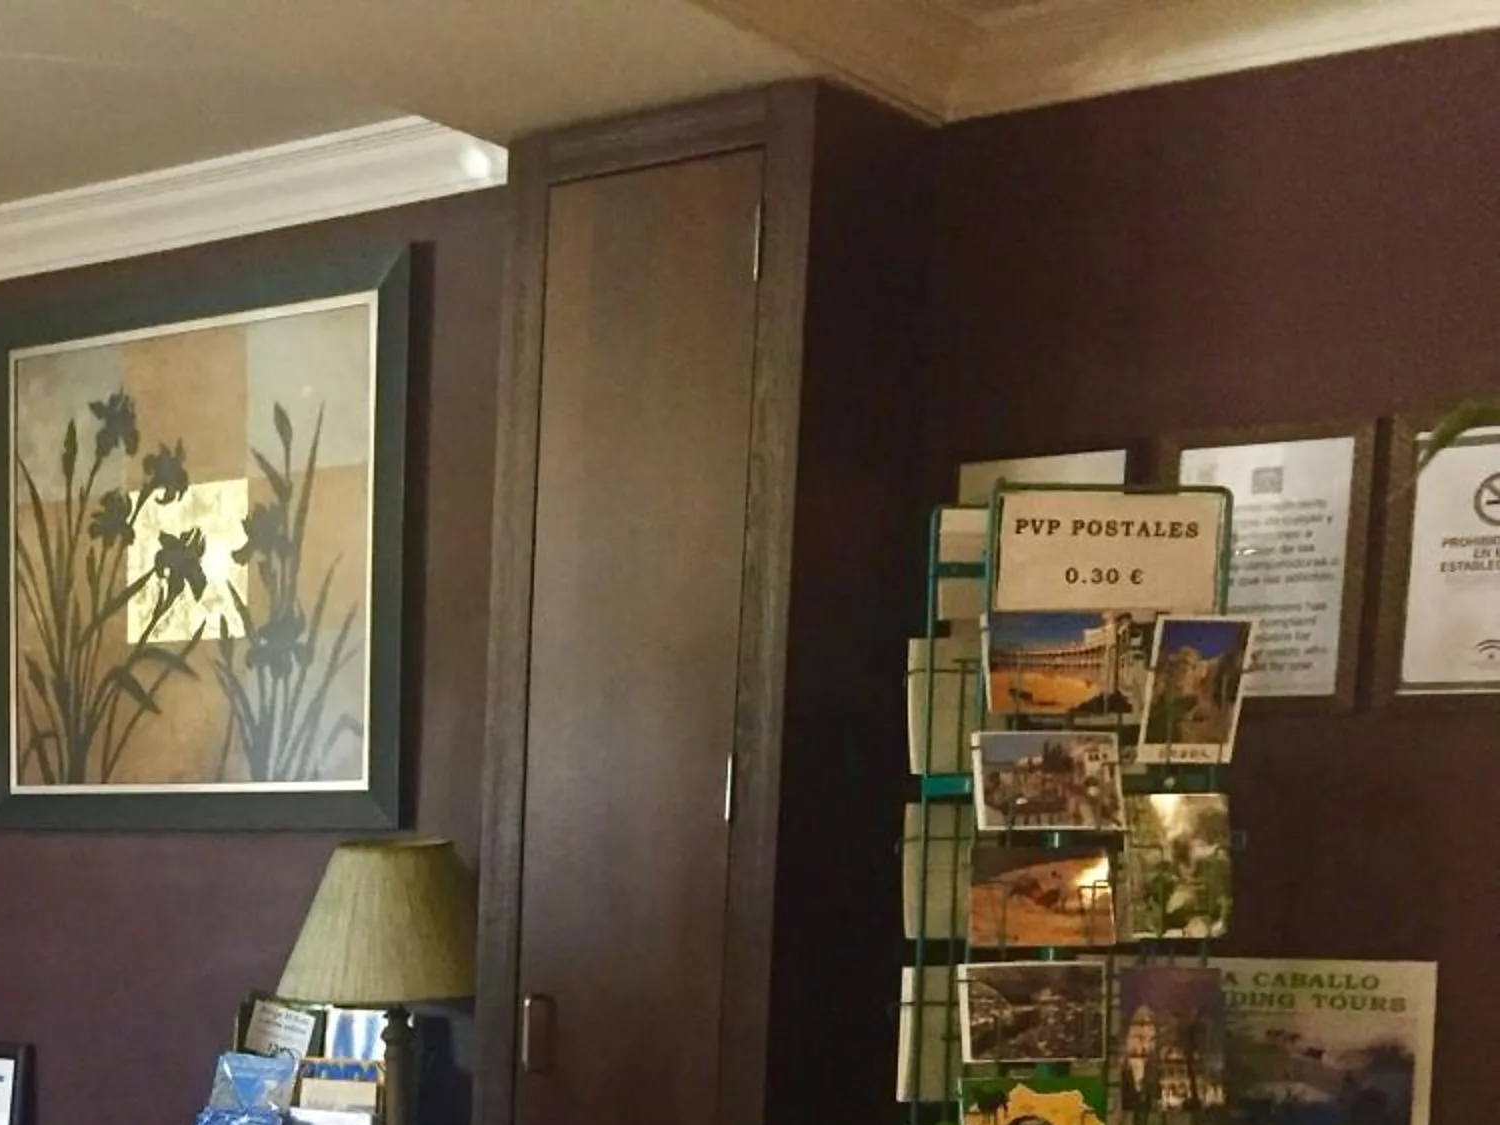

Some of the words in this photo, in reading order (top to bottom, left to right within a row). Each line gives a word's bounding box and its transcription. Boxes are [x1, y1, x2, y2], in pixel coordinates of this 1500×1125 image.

[1015, 518, 1061, 536] PVP
[1071, 519, 1200, 539] POSTALES
[1065, 566, 1120, 585] 0.30
[1130, 568, 1145, 585] €
[1252, 972, 1381, 991] CABALLO
